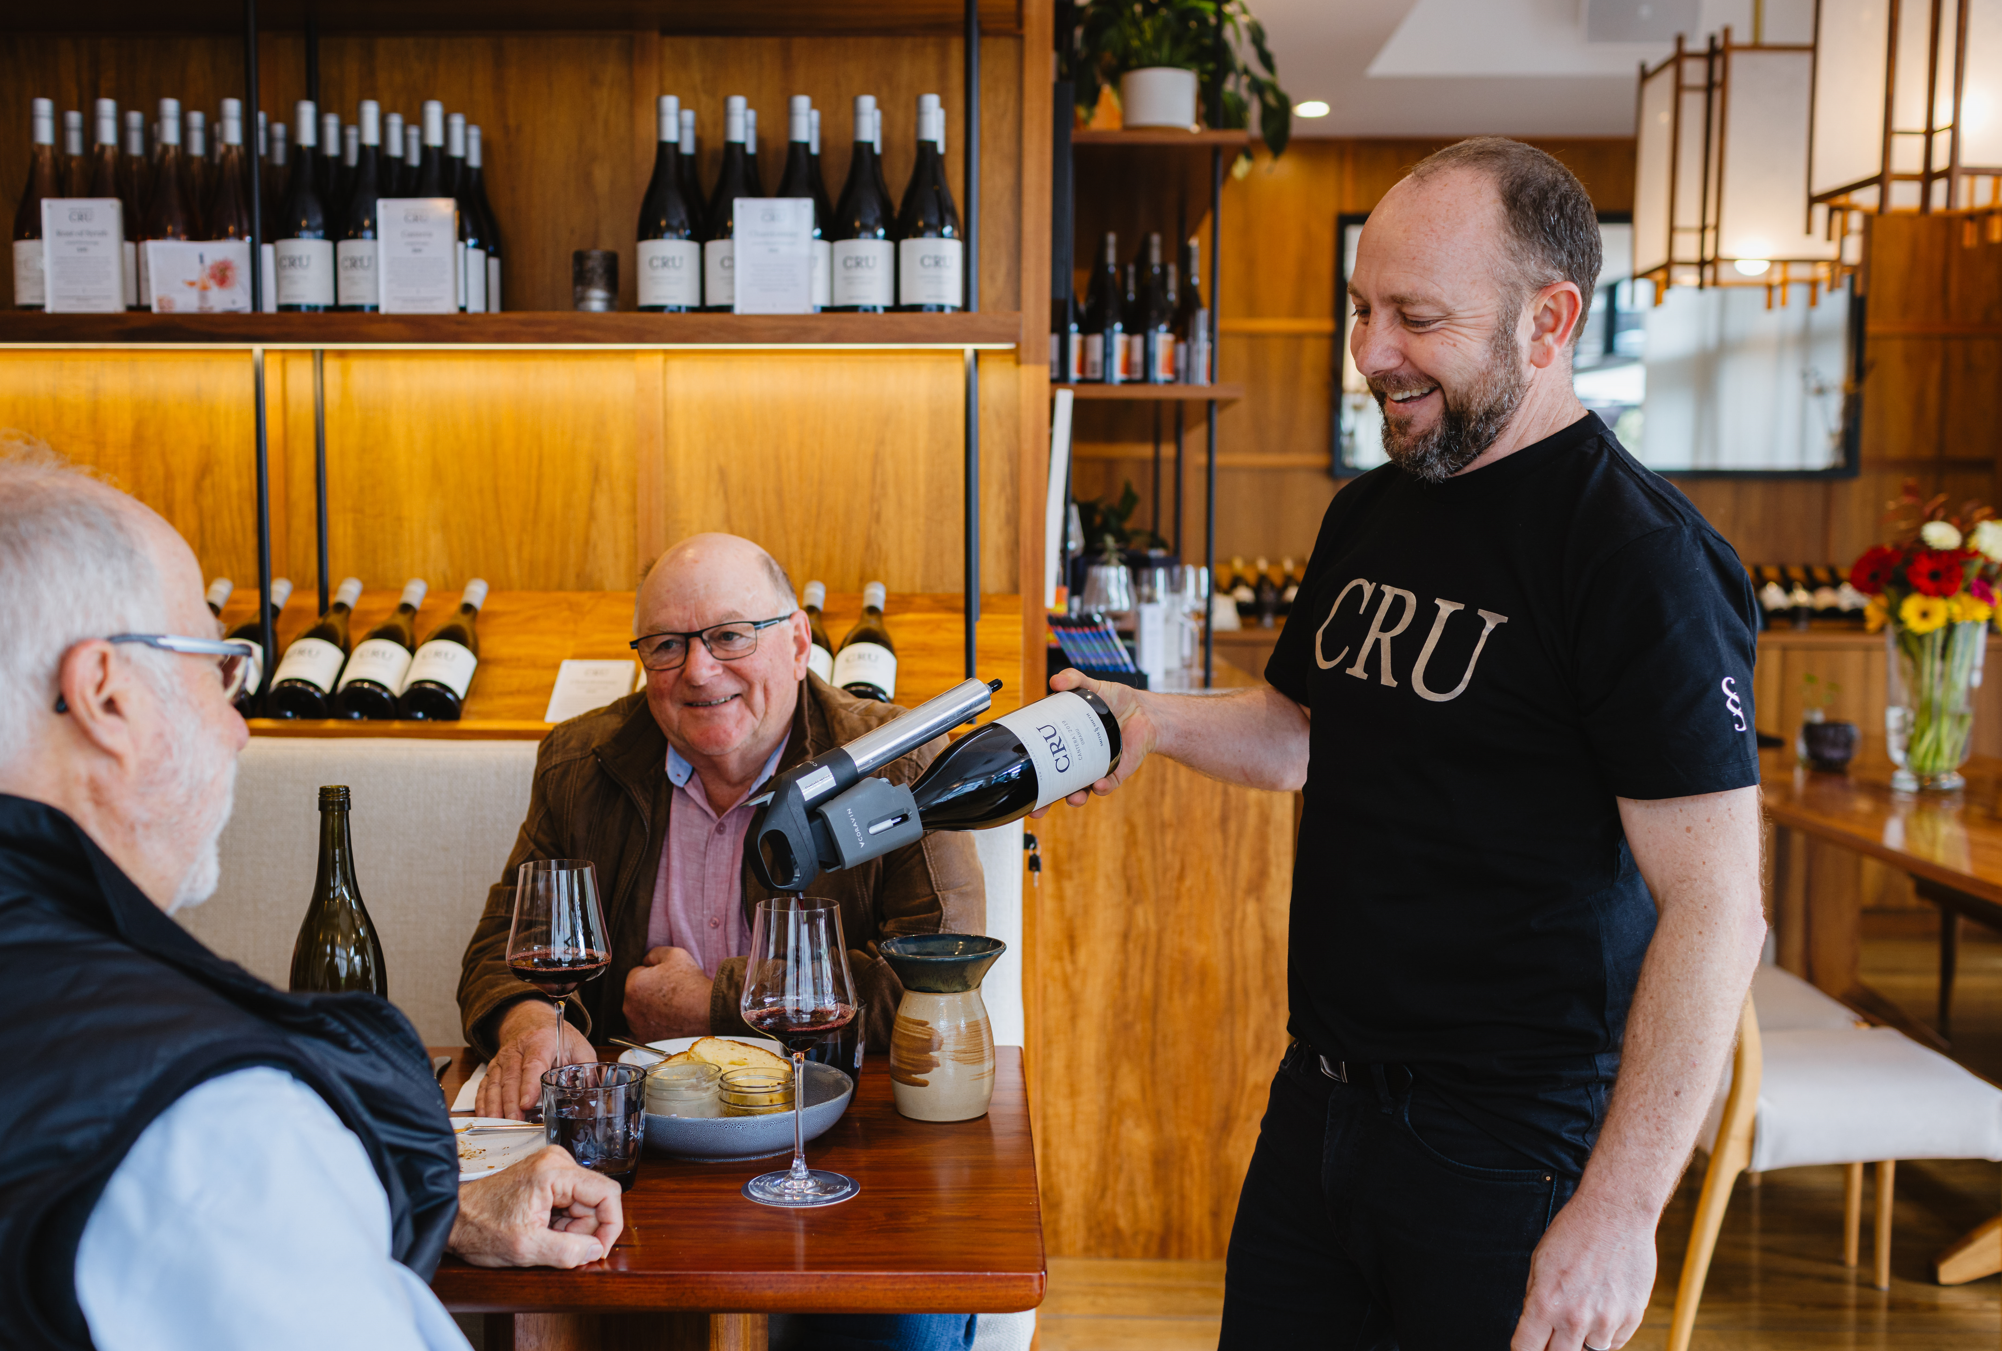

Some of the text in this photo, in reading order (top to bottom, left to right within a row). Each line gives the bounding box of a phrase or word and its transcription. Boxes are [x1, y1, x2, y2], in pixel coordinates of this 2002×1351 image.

[279, 254, 311, 270] CRU
[341, 254, 373, 271] CRU
[648, 254, 684, 271] CRU
[842, 254, 877, 270] CRU
[920, 254, 954, 269] CRU
[1315, 577, 1508, 702] CRU
[1036, 724, 1071, 773] CRU
[1072, 736, 1083, 761] CANTERA
